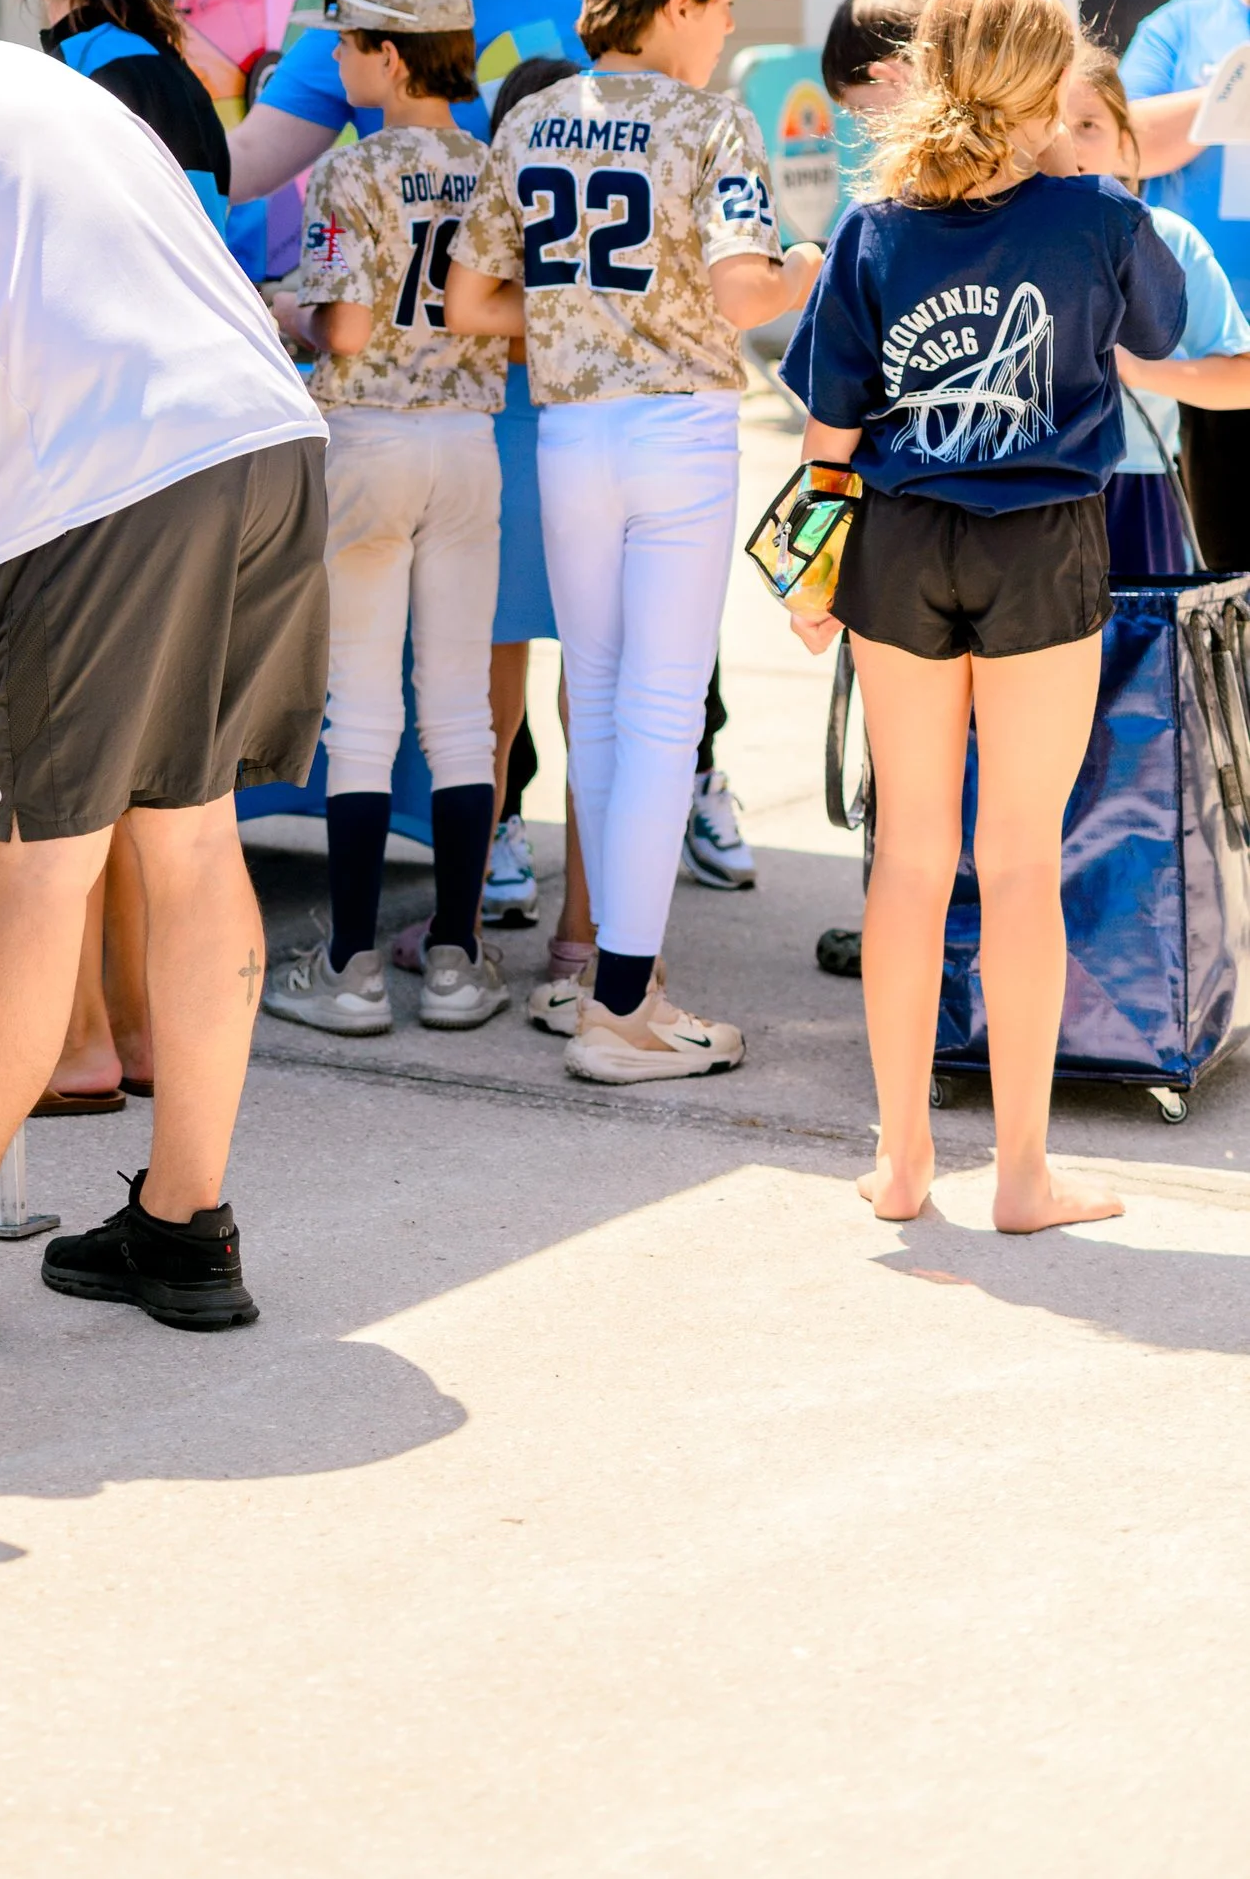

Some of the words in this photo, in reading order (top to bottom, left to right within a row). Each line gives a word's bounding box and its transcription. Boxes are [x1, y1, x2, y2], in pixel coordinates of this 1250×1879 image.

[529, 118, 651, 153] KRAMER
[517, 164, 658, 294] 22
[882, 284, 1000, 398] CAROWINDS
[909, 326, 979, 372] 2026
